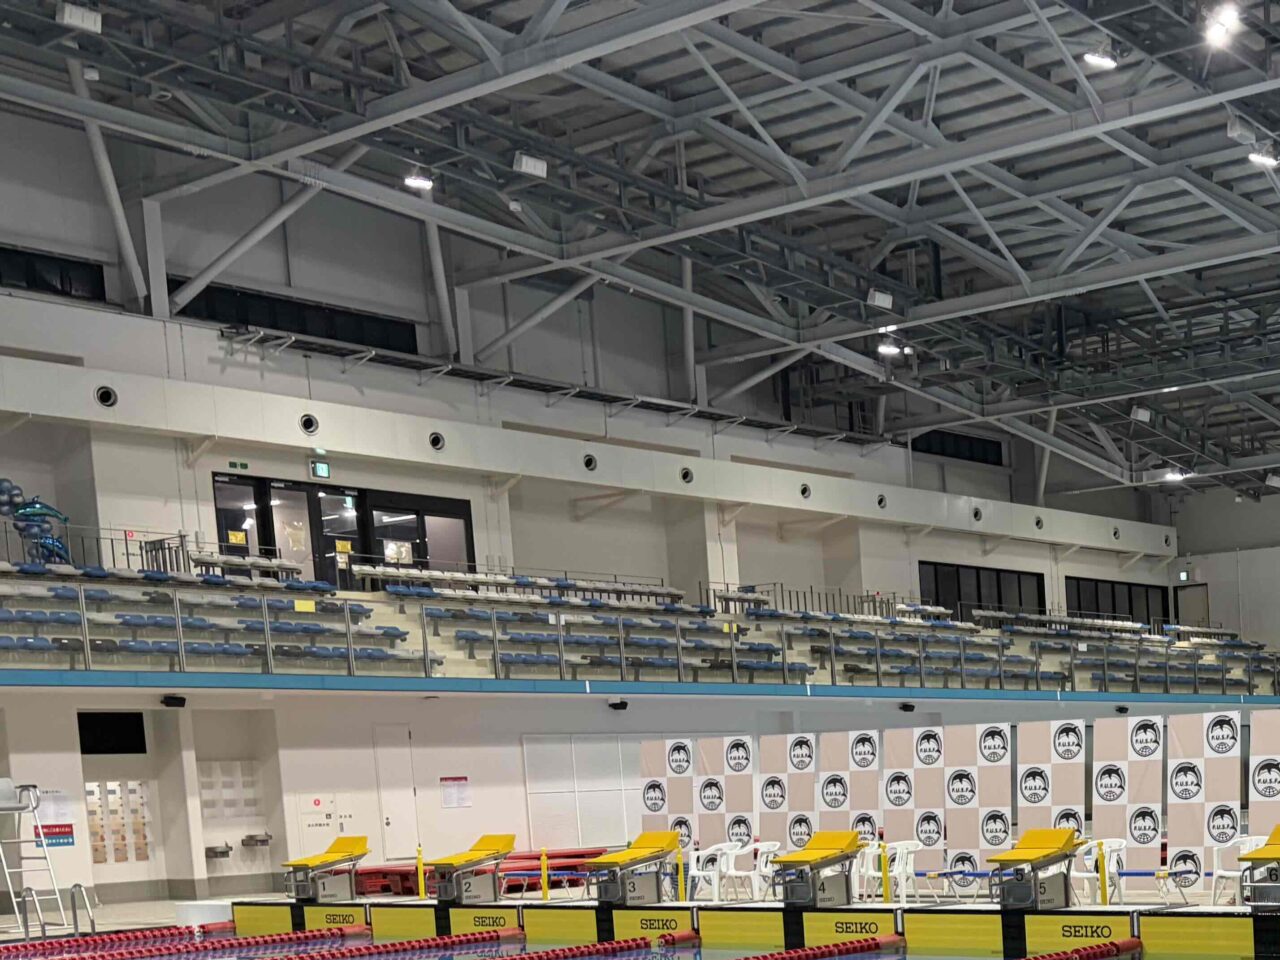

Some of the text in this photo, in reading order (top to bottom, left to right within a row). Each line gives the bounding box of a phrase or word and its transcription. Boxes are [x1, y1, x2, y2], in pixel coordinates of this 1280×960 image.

[609, 871, 615, 880] 3
[797, 870, 803, 880] 4
[1015, 870, 1023, 881] 5
[1270, 869, 1279, 882] 6
[464, 883, 471, 892] 2
[629, 882, 635, 892] 3
[819, 882, 825, 893] 4
[1040, 883, 1046, 894] 5
[326, 914, 354, 923] SEIKO
[474, 917, 505, 926] SEIKO
[640, 919, 677, 930] SEIKO
[835, 922, 878, 933] SEIKO
[1062, 926, 1111, 938] SEIKO
